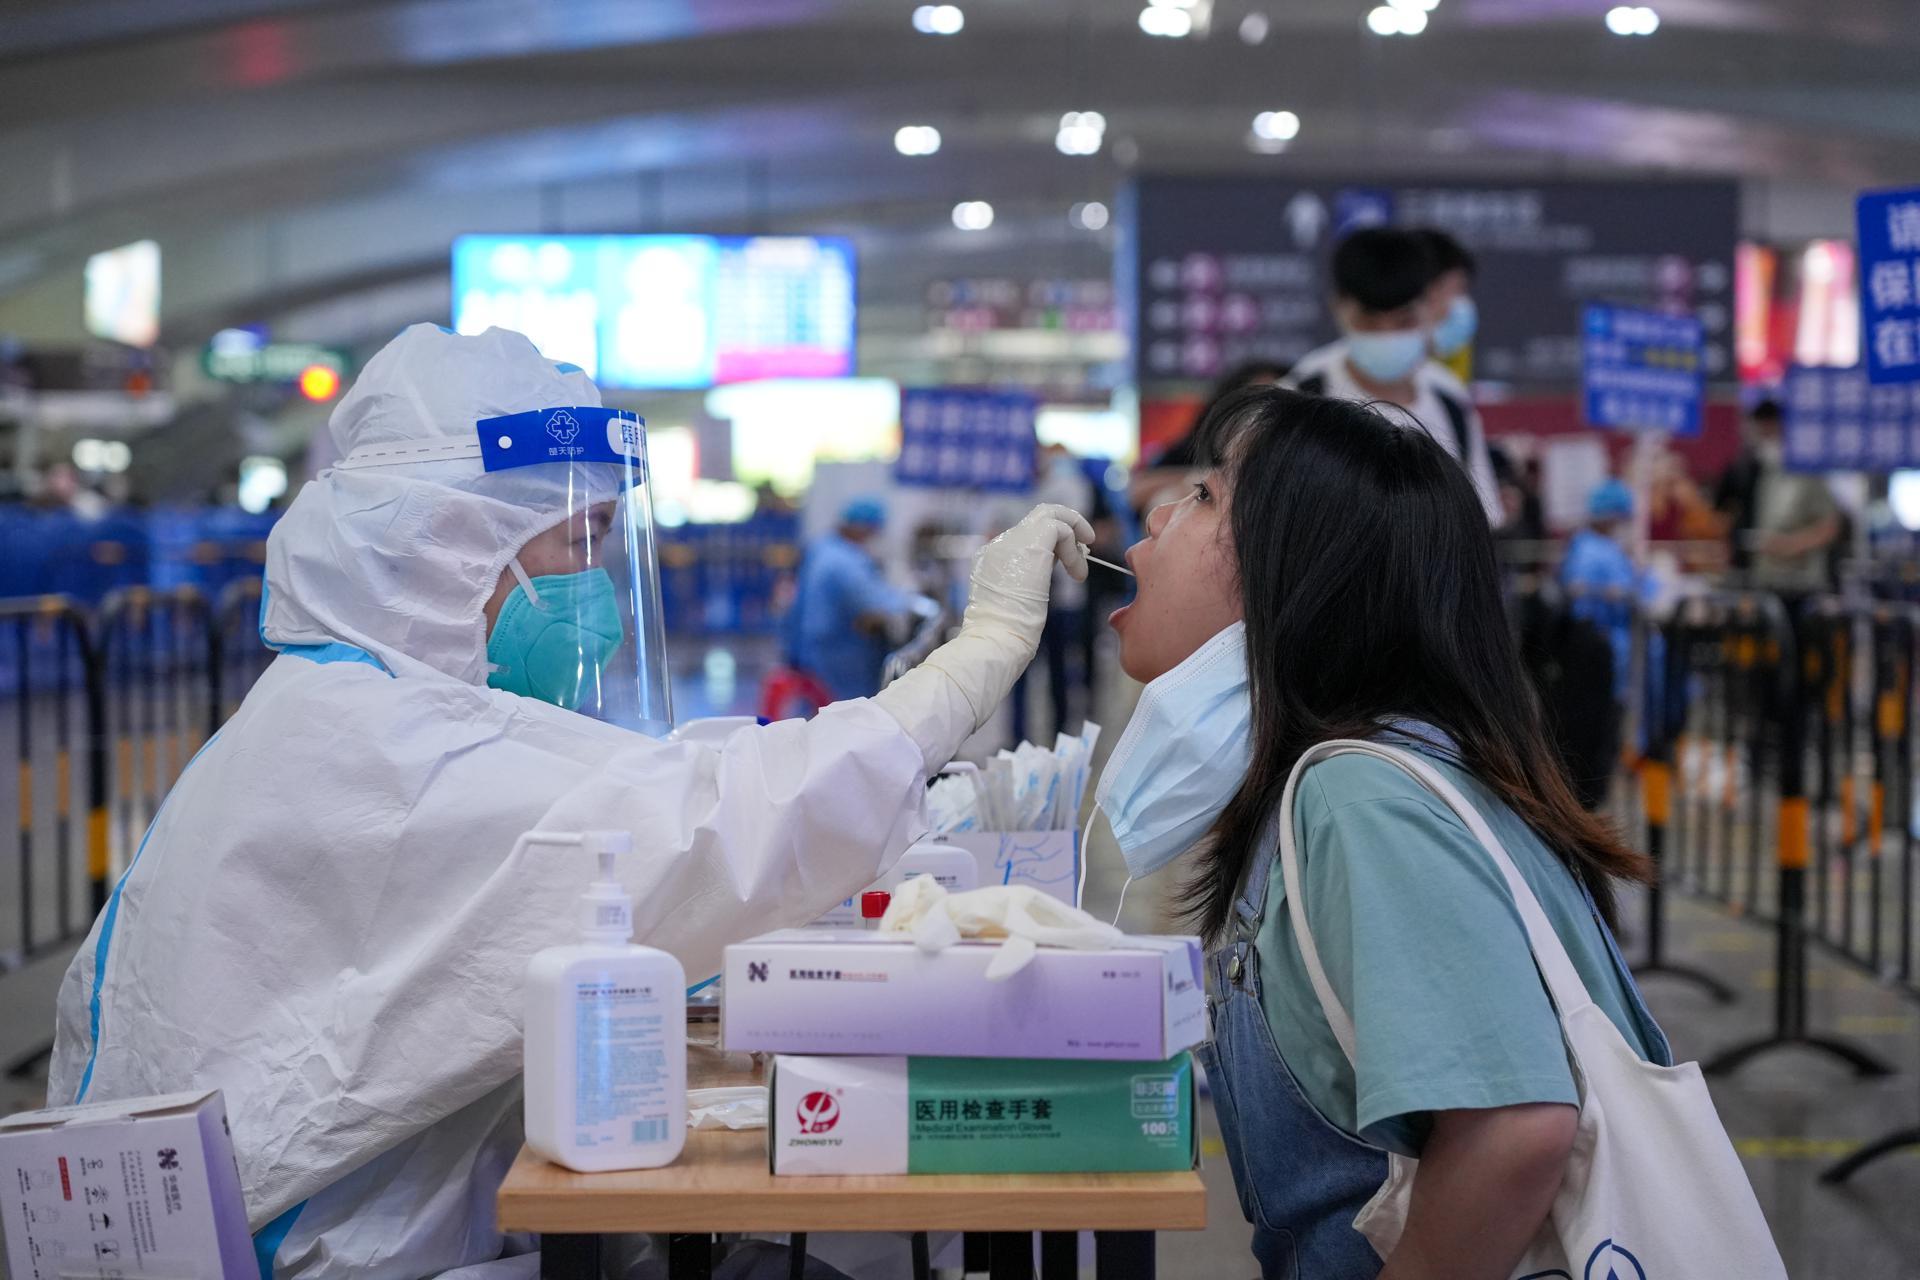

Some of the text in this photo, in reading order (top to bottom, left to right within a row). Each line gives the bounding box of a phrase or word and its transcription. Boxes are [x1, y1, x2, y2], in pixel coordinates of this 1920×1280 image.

[1871, 258, 1920, 311] 保
[1874, 317, 1920, 368] 在
[915, 1098, 1052, 1121] 医用检查手套
[915, 1122, 1052, 1133] Medical Examination Gloves
[1141, 1121, 1179, 1136] 100只
[788, 1137, 843, 1147] ZHONGYU
